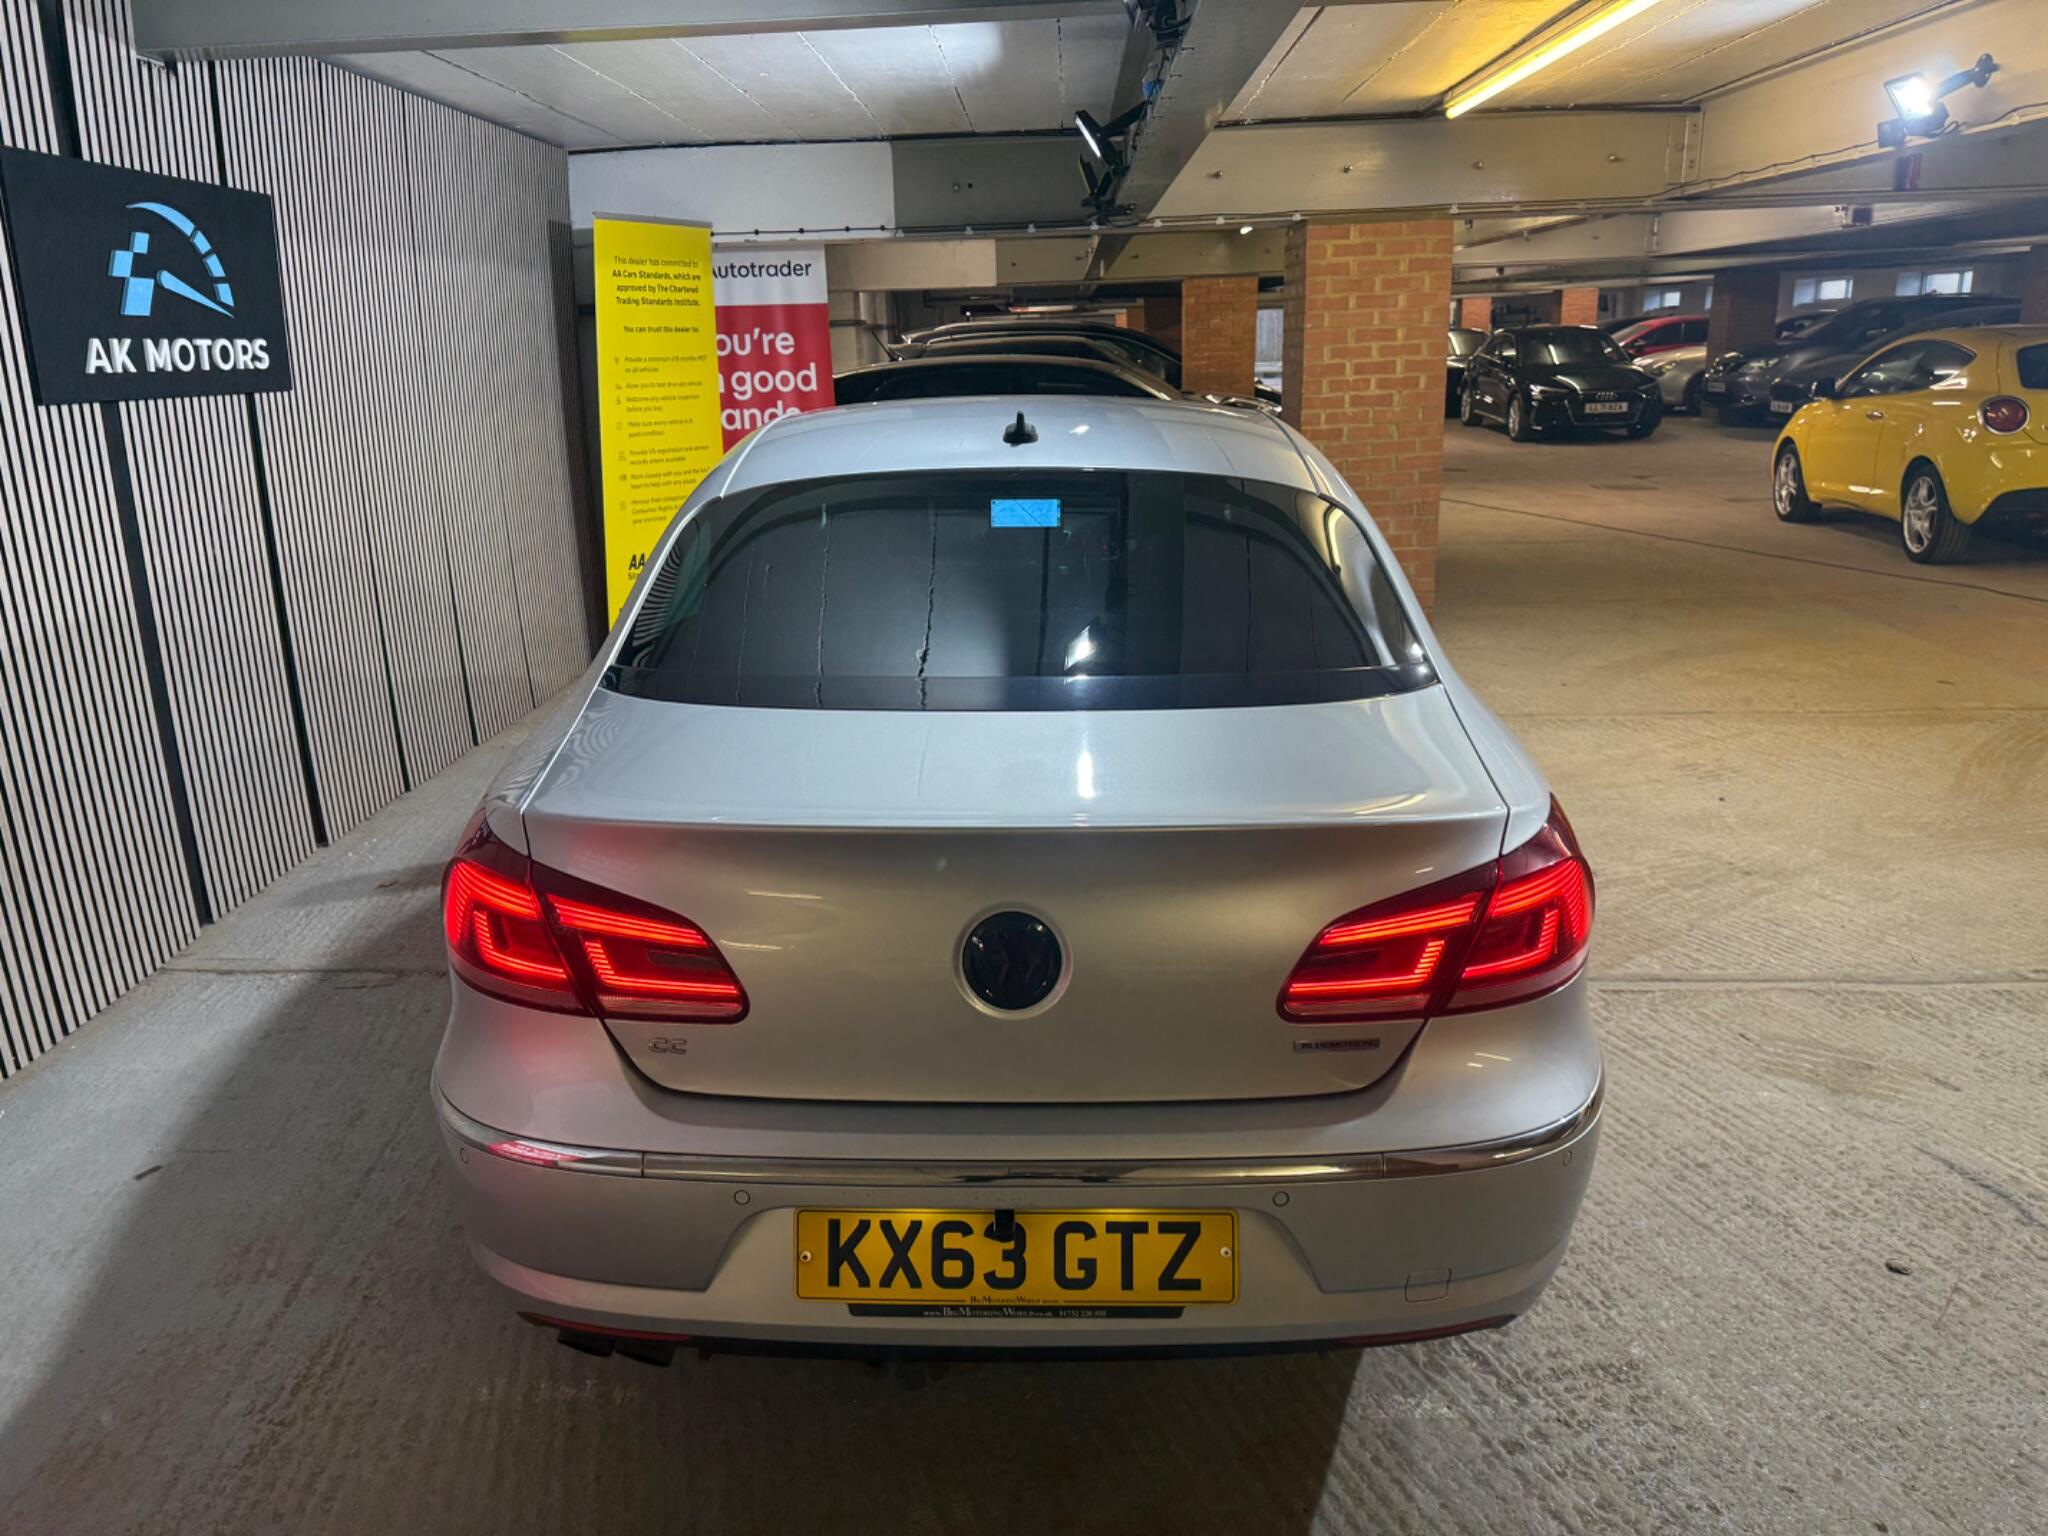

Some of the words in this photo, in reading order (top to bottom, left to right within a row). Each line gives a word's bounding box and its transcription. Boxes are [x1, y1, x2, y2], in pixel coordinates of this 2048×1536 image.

[612, 269, 622, 278] AA
[623, 270, 637, 279] Cars
[674, 272, 691, 281] which
[616, 284, 647, 293] approved
[648, 284, 656, 294] by
[657, 284, 668, 293] The
[669, 285, 699, 294] Chartered
[616, 296, 640, 307] Trading
[641, 297, 673, 306] Standards
[715, 327, 796, 356] ou're
[86, 338, 137, 374] AK
[143, 338, 271, 373] MOTORS
[731, 362, 818, 401] good
[721, 400, 801, 431] and
[629, 553, 646, 571] AA
[648, 1037, 688, 1055] CC
[827, 1218, 1027, 1290] KX63
[1053, 1220, 1202, 1292] GTZ
